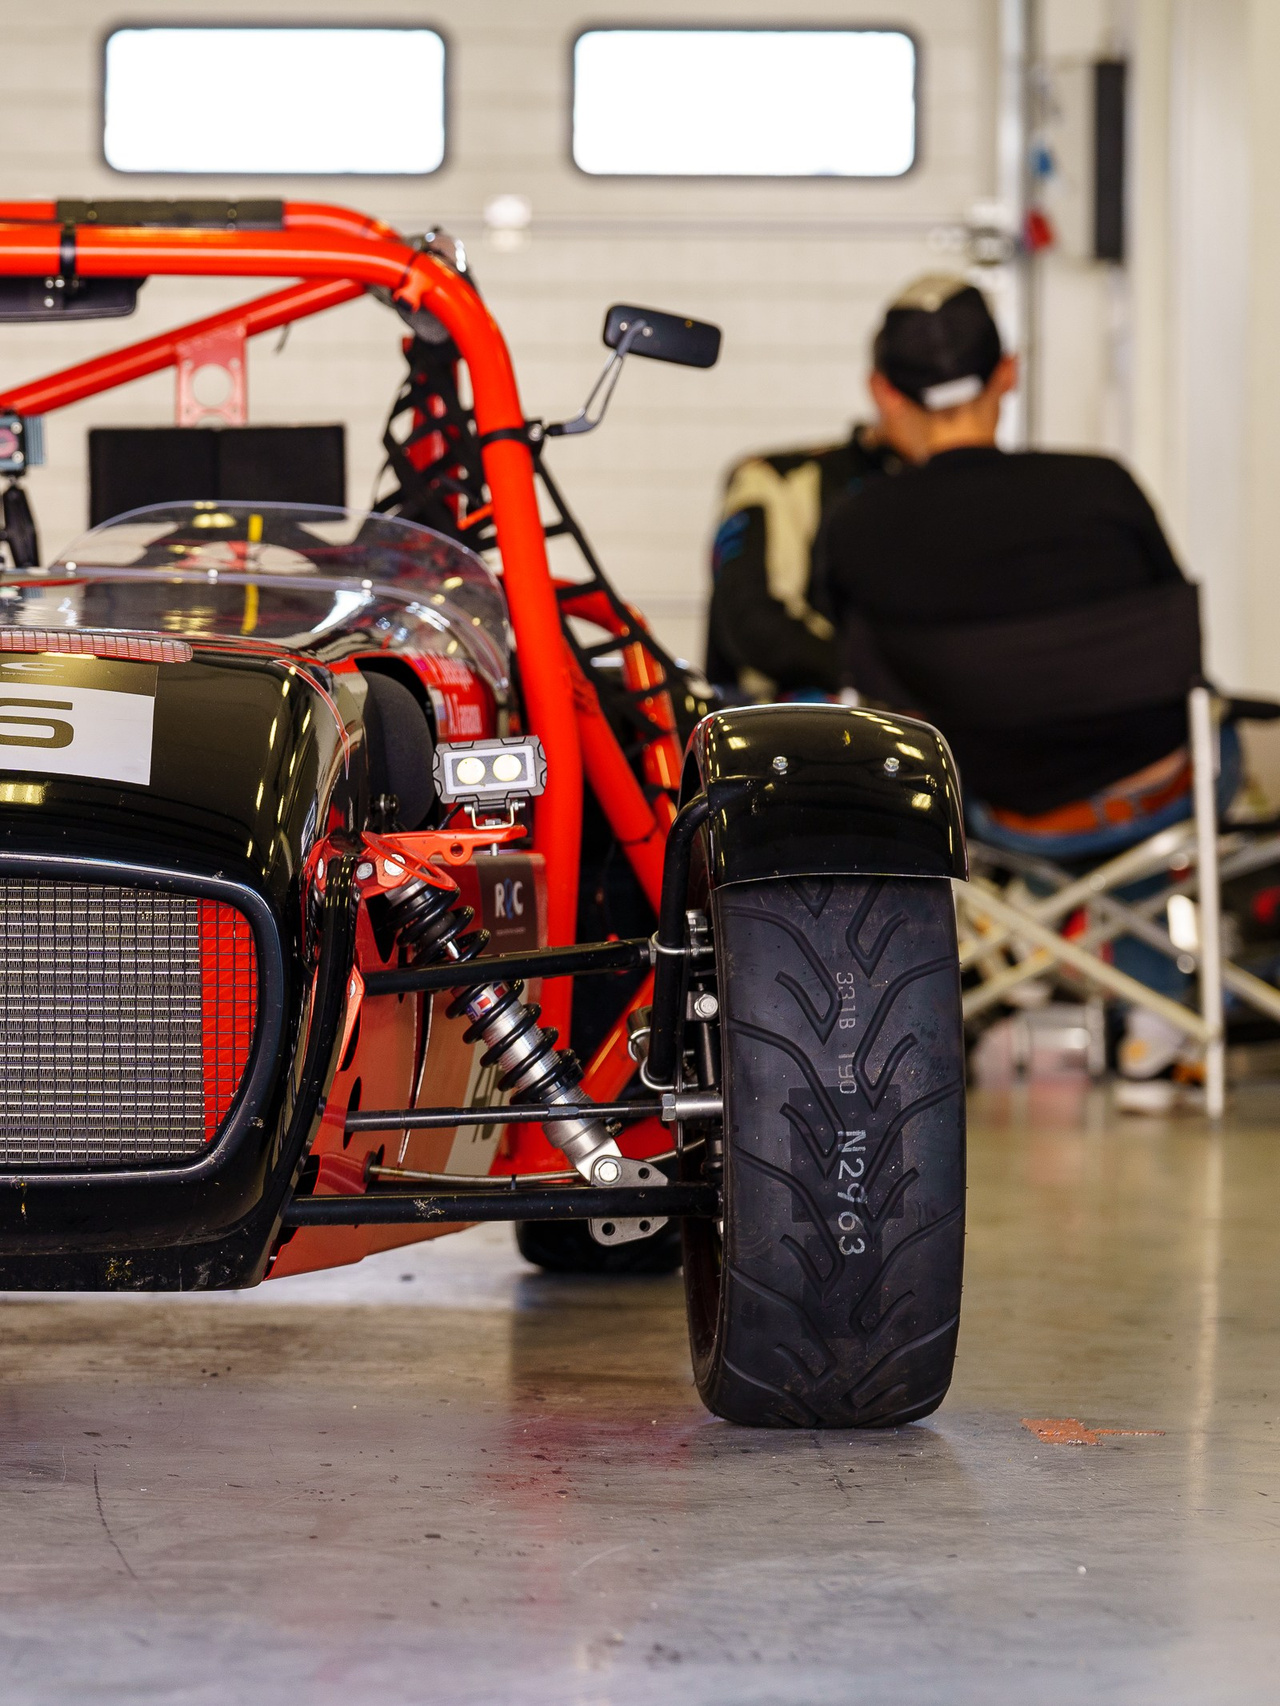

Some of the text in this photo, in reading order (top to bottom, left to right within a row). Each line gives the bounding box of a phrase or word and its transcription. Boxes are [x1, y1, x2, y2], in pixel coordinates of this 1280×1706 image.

[836, 972, 868, 1256] 331B 190 N2963
